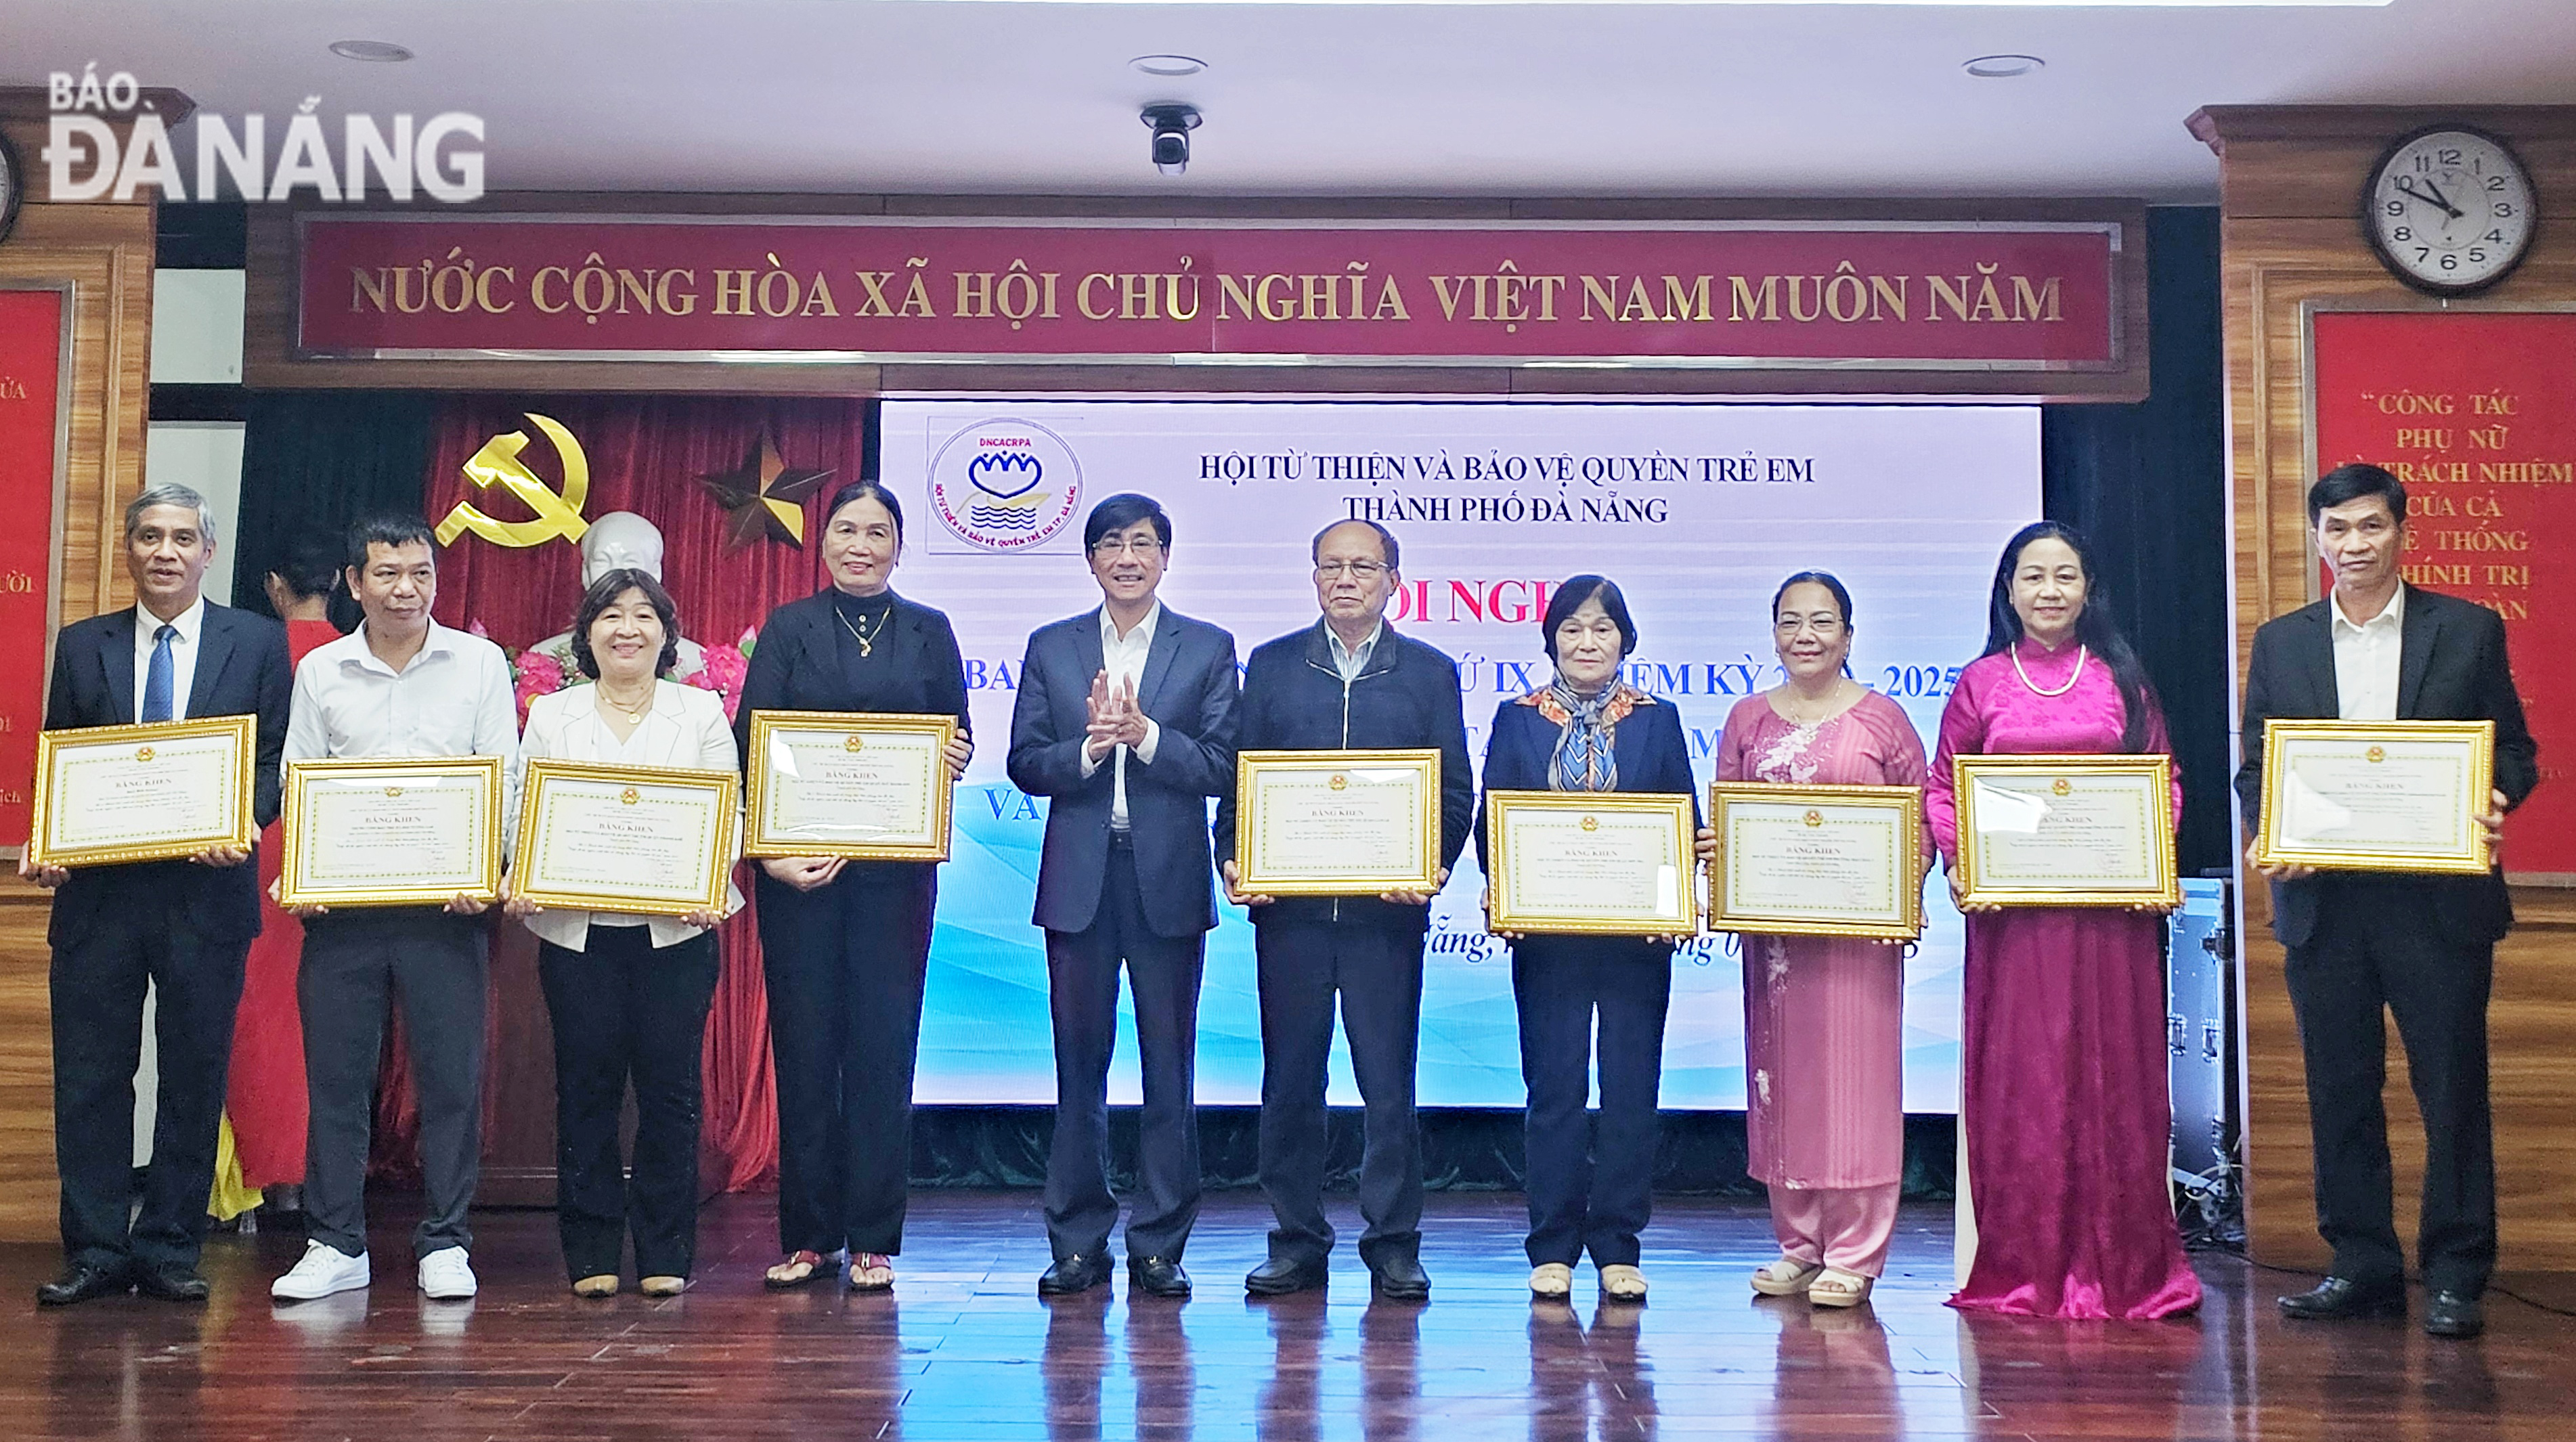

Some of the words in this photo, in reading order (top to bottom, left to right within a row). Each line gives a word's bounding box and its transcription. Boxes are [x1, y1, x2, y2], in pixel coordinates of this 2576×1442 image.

[2416, 154, 2429, 172] 11
[2438, 149, 2462, 165] 12
[2474, 156, 2481, 175] 1
[2394, 175, 2413, 191] 10
[2487, 176, 2505, 191] 2
[2386, 201, 2403, 216] 9
[2494, 203, 2512, 217] 3
[2393, 227, 2411, 241] 8
[2484, 229, 2503, 244] 4
[2414, 247, 2429, 263] 7
[2440, 255, 2457, 269] 6
[2469, 248, 2485, 262] 5
[351, 246, 515, 314] NƯỚC
[531, 251, 699, 324] CỘNG
[712, 253, 839, 318] HÒA
[854, 257, 937, 318] XÃ
[953, 259, 1060, 330] HỘI
[1077, 255, 1200, 321] CHỦ
[1216, 261, 1411, 322] NGHĨA
[1429, 259, 1565, 333] VIỆT
[1579, 274, 1714, 322] NAM
[1728, 260, 1907, 323] MUÔN
[1925, 263, 2064, 323] NĂM
[2468, 388, 2519, 415] TÁC
[980, 438, 1031, 447] DNCACRPA
[2396, 428, 2453, 454] PHỤ
[2468, 424, 2509, 450] NỮ
[1199, 450, 1256, 485] HỘI
[1262, 449, 1307, 480] TỪ
[1311, 450, 1406, 486] THIỆN
[1411, 448, 1456, 481] VÀ
[1464, 449, 1527, 481] BẢO
[1533, 450, 1576, 486] VỆ
[1581, 449, 1690, 489] QUYỀN
[1697, 449, 1760, 483] TRẺ
[1767, 458, 1816, 483] EM
[2479, 457, 2574, 488] NHIỆM
[1342, 490, 1451, 523] THÀNH
[1459, 493, 1527, 523] PHỐ
[1529, 486, 1576, 523] ĐÀ
[1580, 491, 1669, 524] NẴNG
[2405, 490, 2458, 517] CỦA
[2465, 489, 2504, 517] CẢ
[2435, 519, 2529, 552] THỐNG
[2482, 565, 2530, 590] TRỊ
[1493, 661, 1537, 696] IX
[1704, 653, 1765, 695] KỲ
